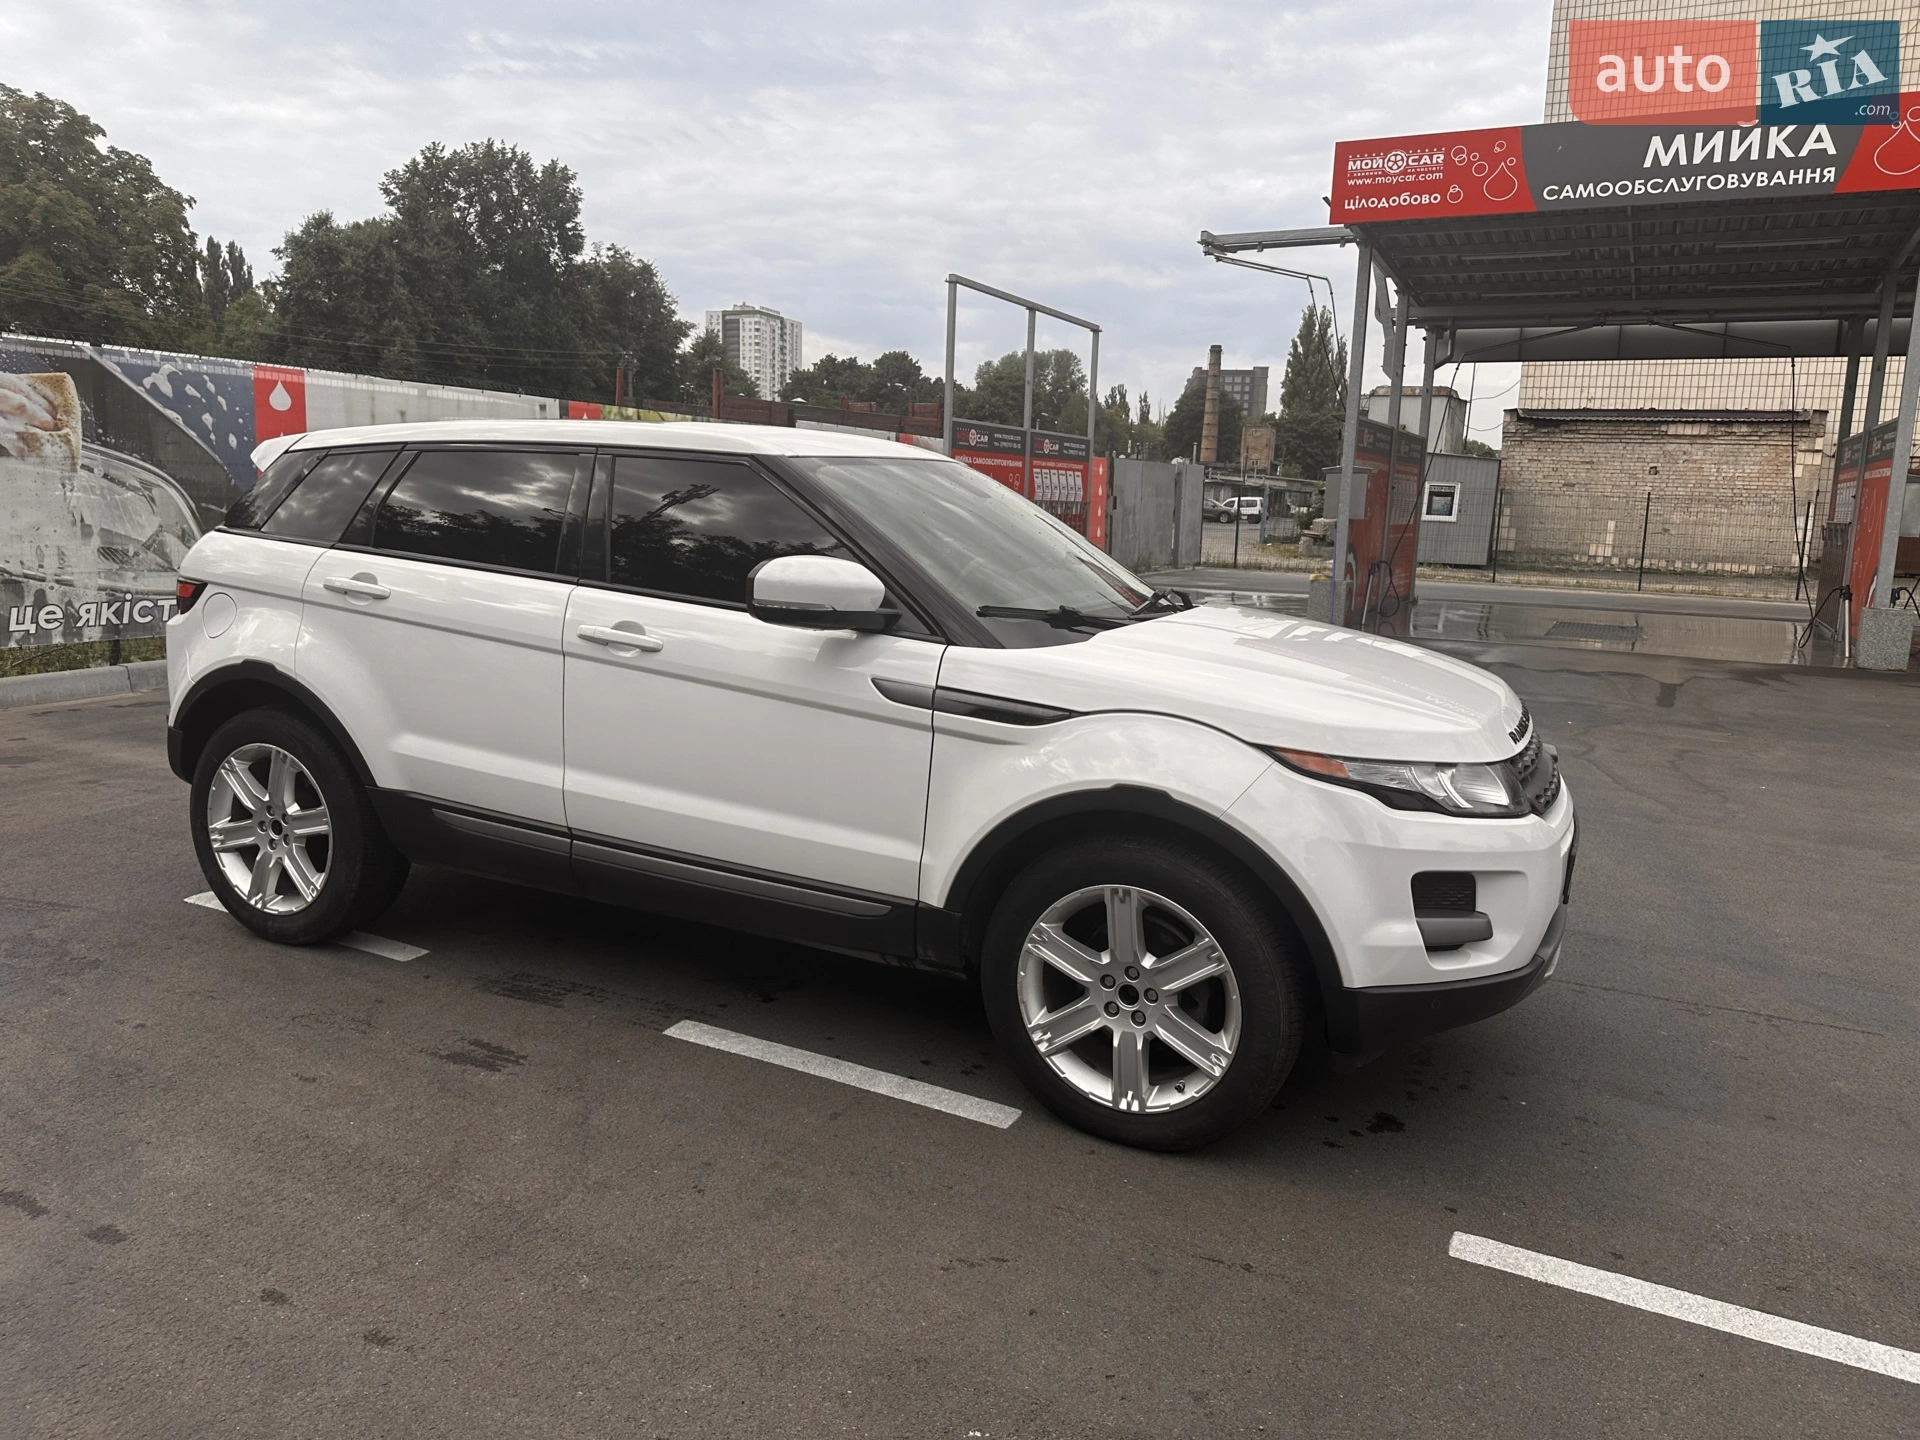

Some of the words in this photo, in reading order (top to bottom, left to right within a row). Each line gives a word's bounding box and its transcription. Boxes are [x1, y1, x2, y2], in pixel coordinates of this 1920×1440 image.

[1643, 119, 1838, 169] МИЙКА
[1347, 157, 1384, 171] МОЙ
[1408, 153, 1445, 166] CAR
[1347, 172, 1443, 186] www.moycar.com
[1542, 166, 1837, 201] САМООБСЛУГОВУВАННЯ
[1344, 191, 1441, 210] цілодобово
[8, 603, 65, 635] це
